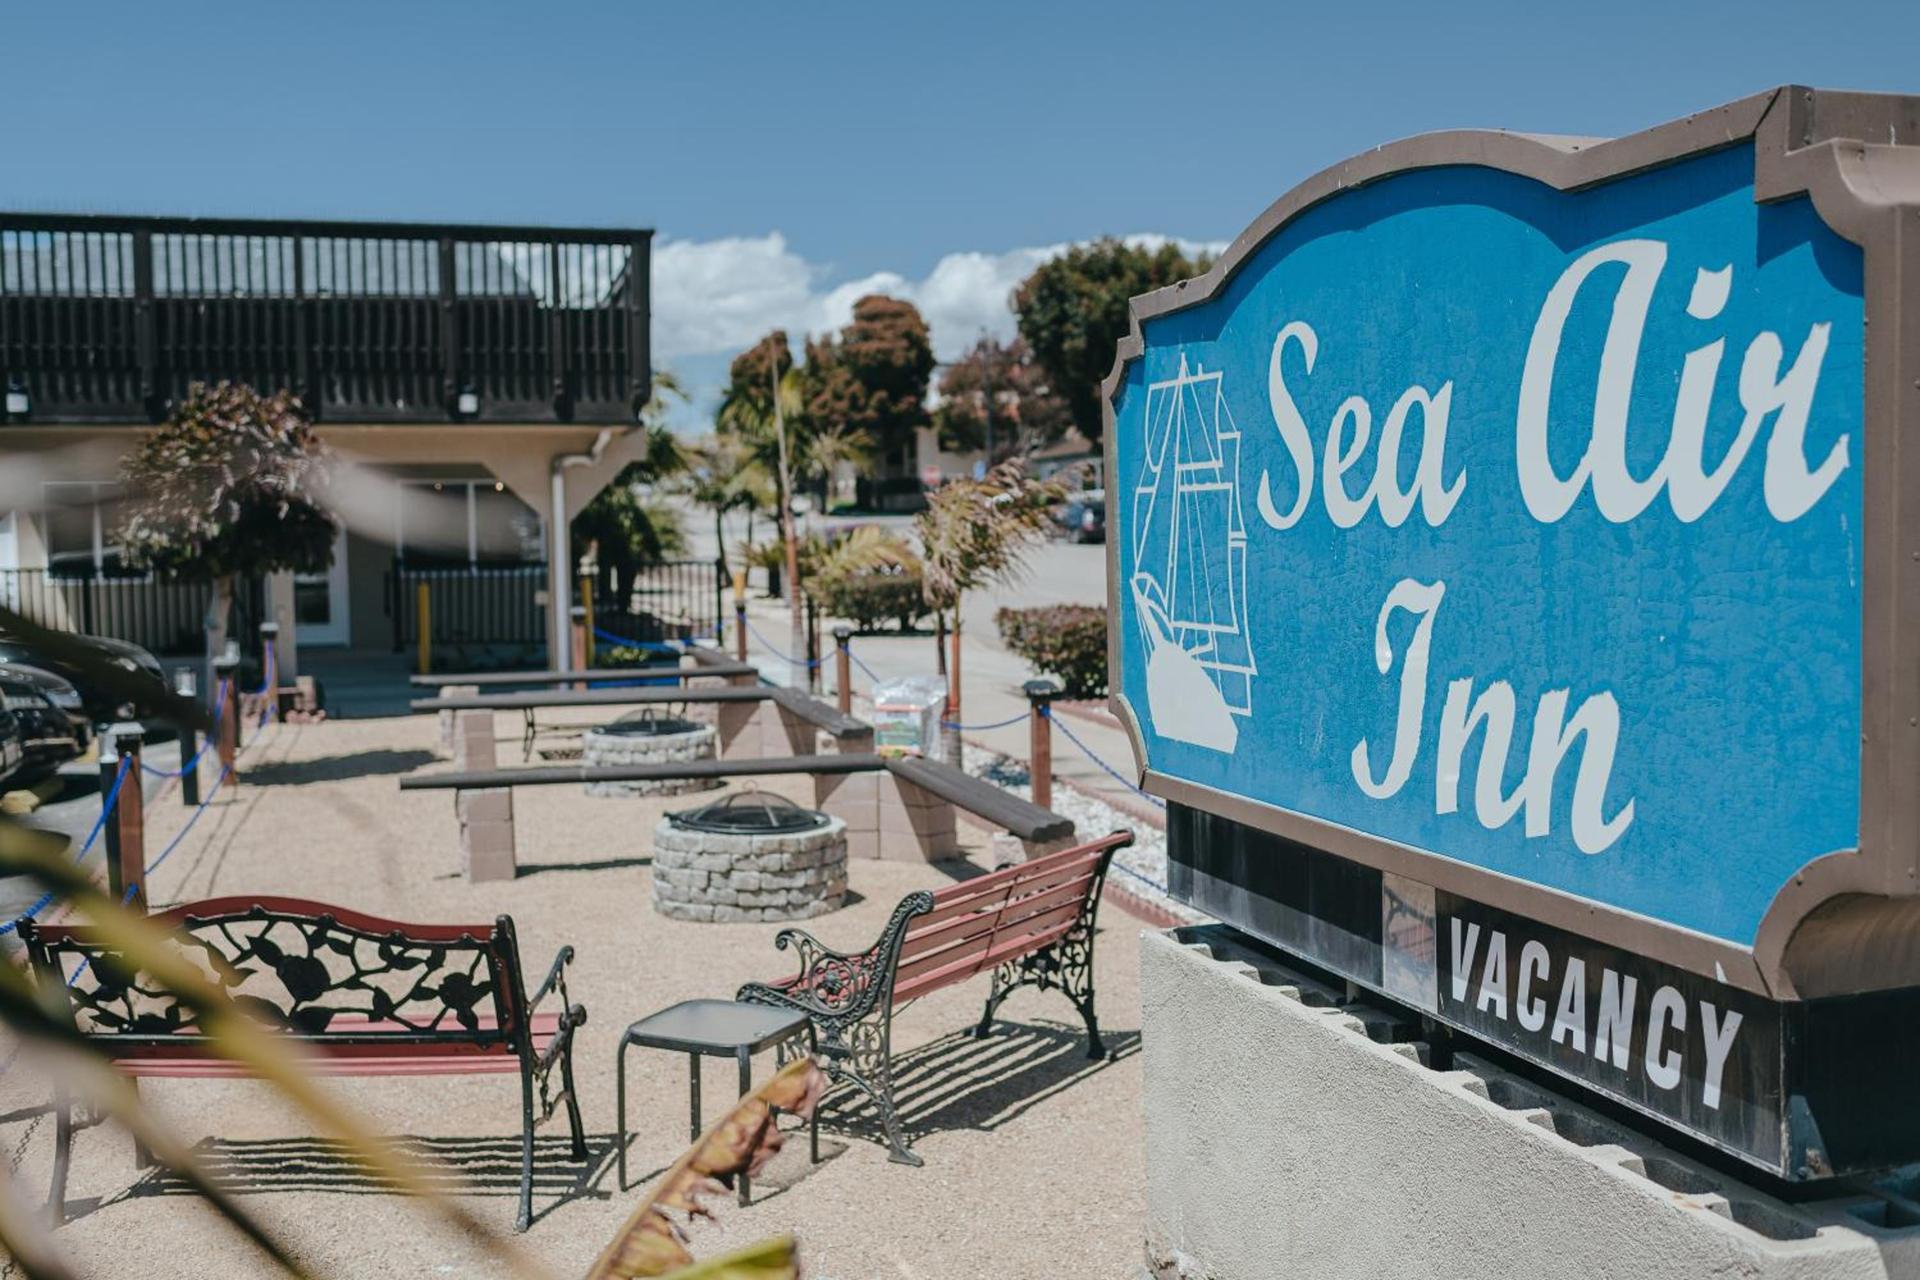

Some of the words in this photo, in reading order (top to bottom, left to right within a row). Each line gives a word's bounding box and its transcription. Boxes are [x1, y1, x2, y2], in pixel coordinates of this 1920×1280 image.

[1257, 321, 1467, 529] Sea
[1516, 239, 1850, 523] Air
[1351, 578, 1635, 854] Inn
[1450, 917, 1743, 1109] VACANCY
